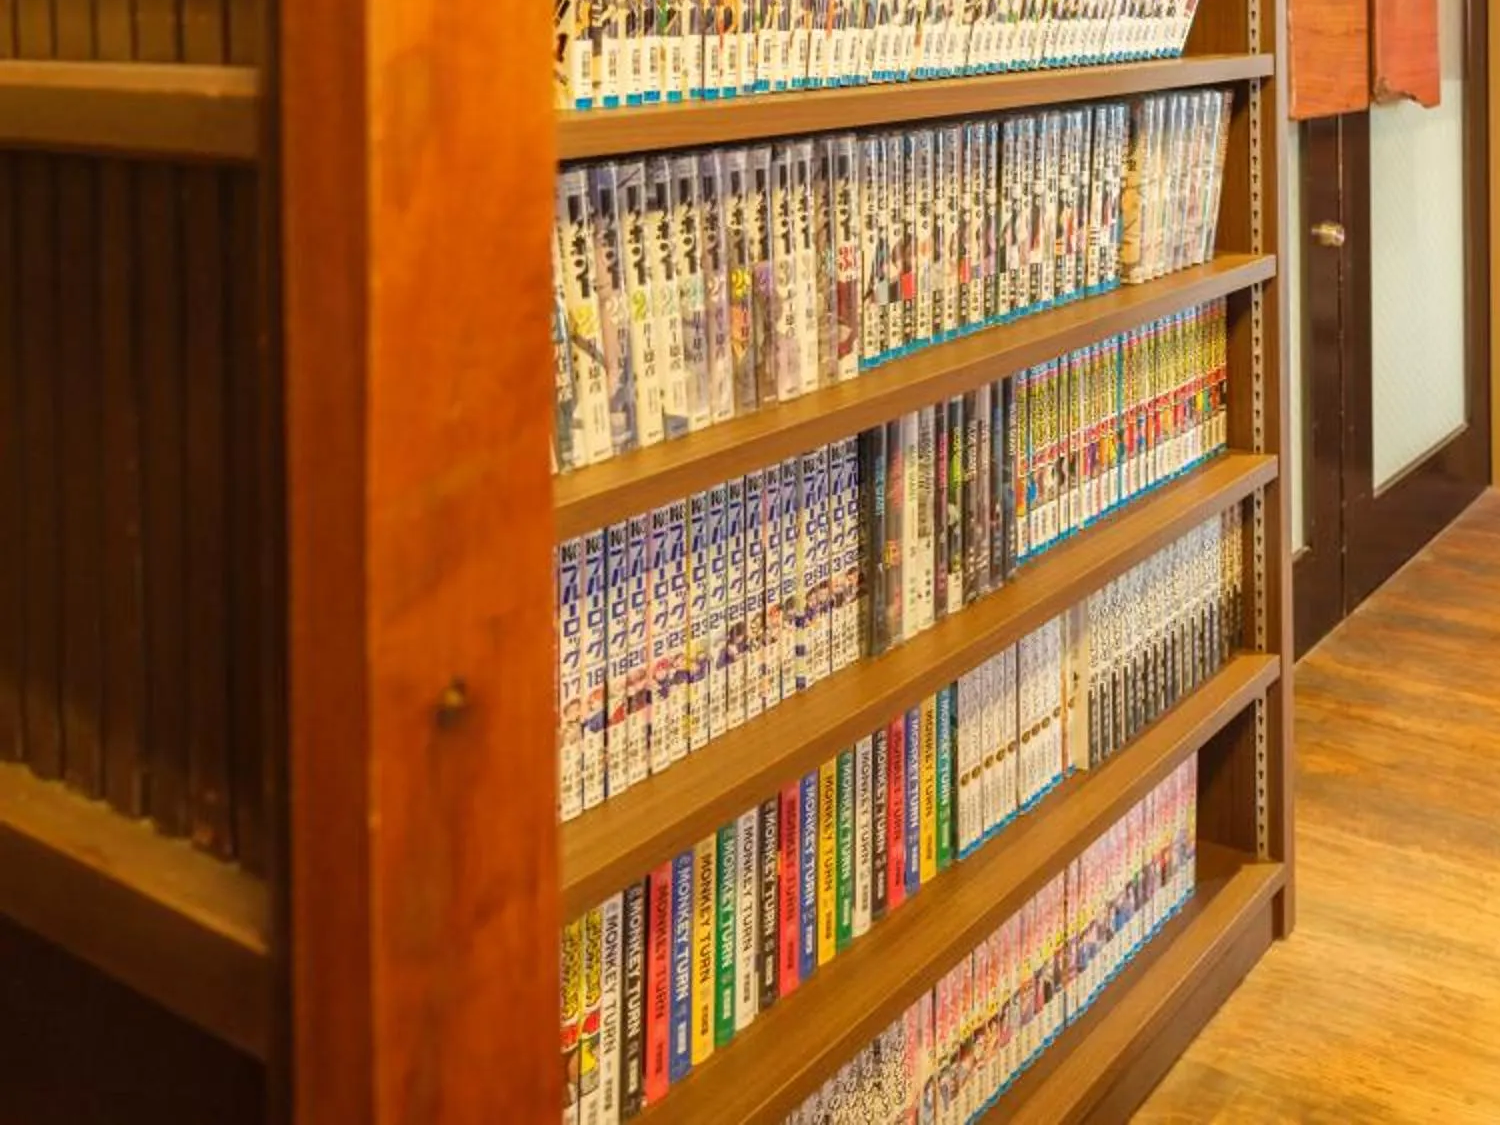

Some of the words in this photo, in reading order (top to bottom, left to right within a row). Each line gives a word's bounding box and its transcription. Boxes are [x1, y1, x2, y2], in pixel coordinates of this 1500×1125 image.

[562, 676, 581, 700] 17
[909, 718, 920, 781] MONKEY
[925, 709, 934, 769] MONKEY
[940, 698, 950, 761] MONKEY
[841, 763, 853, 830] MONKEY
[860, 749, 871, 813] MONKEY
[875, 739, 888, 810] MONKEY
[908, 782, 919, 828] TURN
[924, 773, 934, 819] TURN
[940, 761, 951, 805] TURN
[804, 789, 817, 856] MONKEY
[823, 776, 835, 843] MONKEY
[875, 811, 887, 859] TURN
[742, 824, 755, 897] MONKEY
[765, 810, 778, 886] MONKEY
[822, 845, 834, 893] TURN
[840, 831, 852, 881] TURN
[859, 819, 870, 866] TURN
[676, 866, 692, 944] MONKEY
[700, 852, 714, 927] MONKEY
[722, 842, 737, 914] MONKEY
[803, 857, 816, 907] TURN
[627, 901, 642, 977] MONKEY
[656, 883, 670, 962] MONKEY
[721, 915, 735, 969] TURN
[742, 900, 754, 953] TURN
[764, 886, 777, 937] TURN
[605, 913, 619, 993] MONKEY
[675, 945, 690, 1003] TURN
[699, 928, 713, 986] TURN
[626, 978, 641, 1039] TURN
[655, 964, 668, 1021] TURN
[603, 994, 617, 1055] TURN
